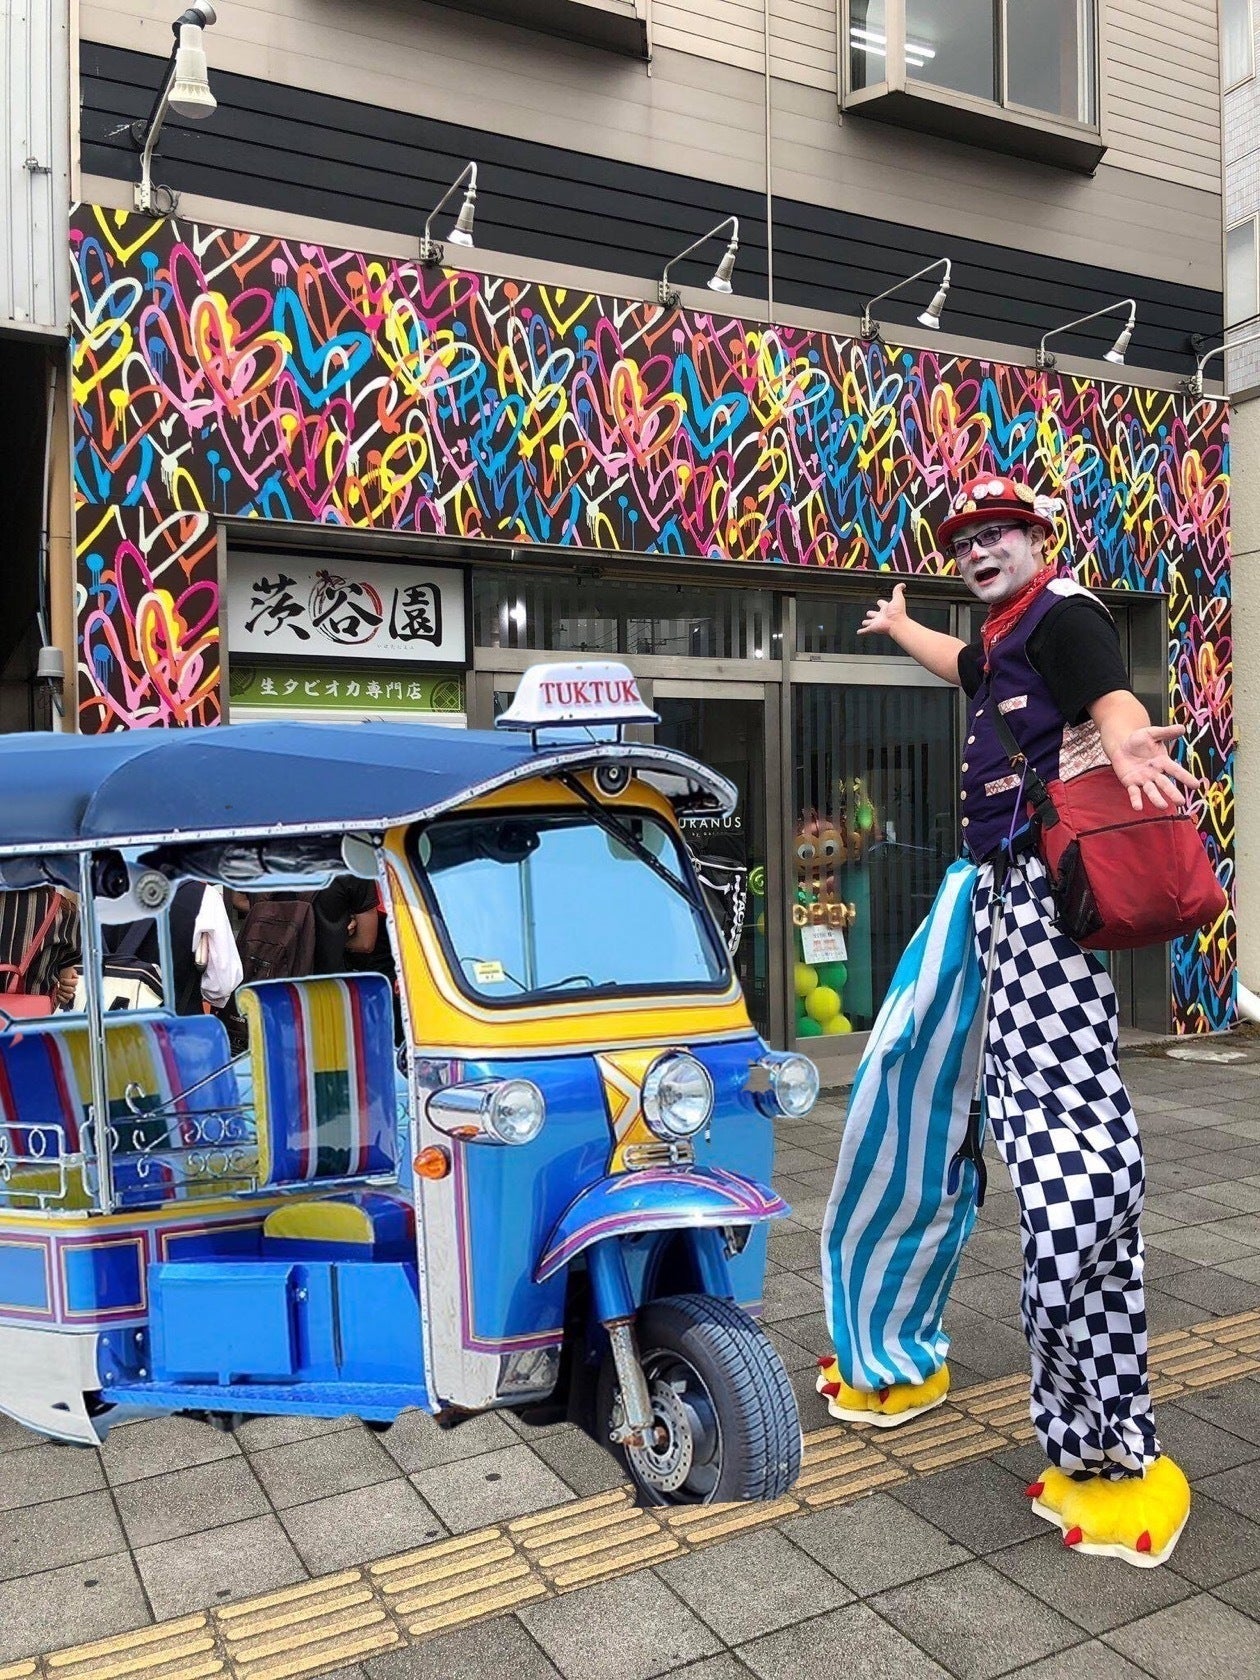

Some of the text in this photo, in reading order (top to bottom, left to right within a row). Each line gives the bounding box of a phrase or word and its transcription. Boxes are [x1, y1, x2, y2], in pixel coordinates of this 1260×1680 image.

[244, 573, 443, 647] 茨谷園
[539, 679, 640, 706] TUKTUK
[678, 816, 742, 829] URANUS
